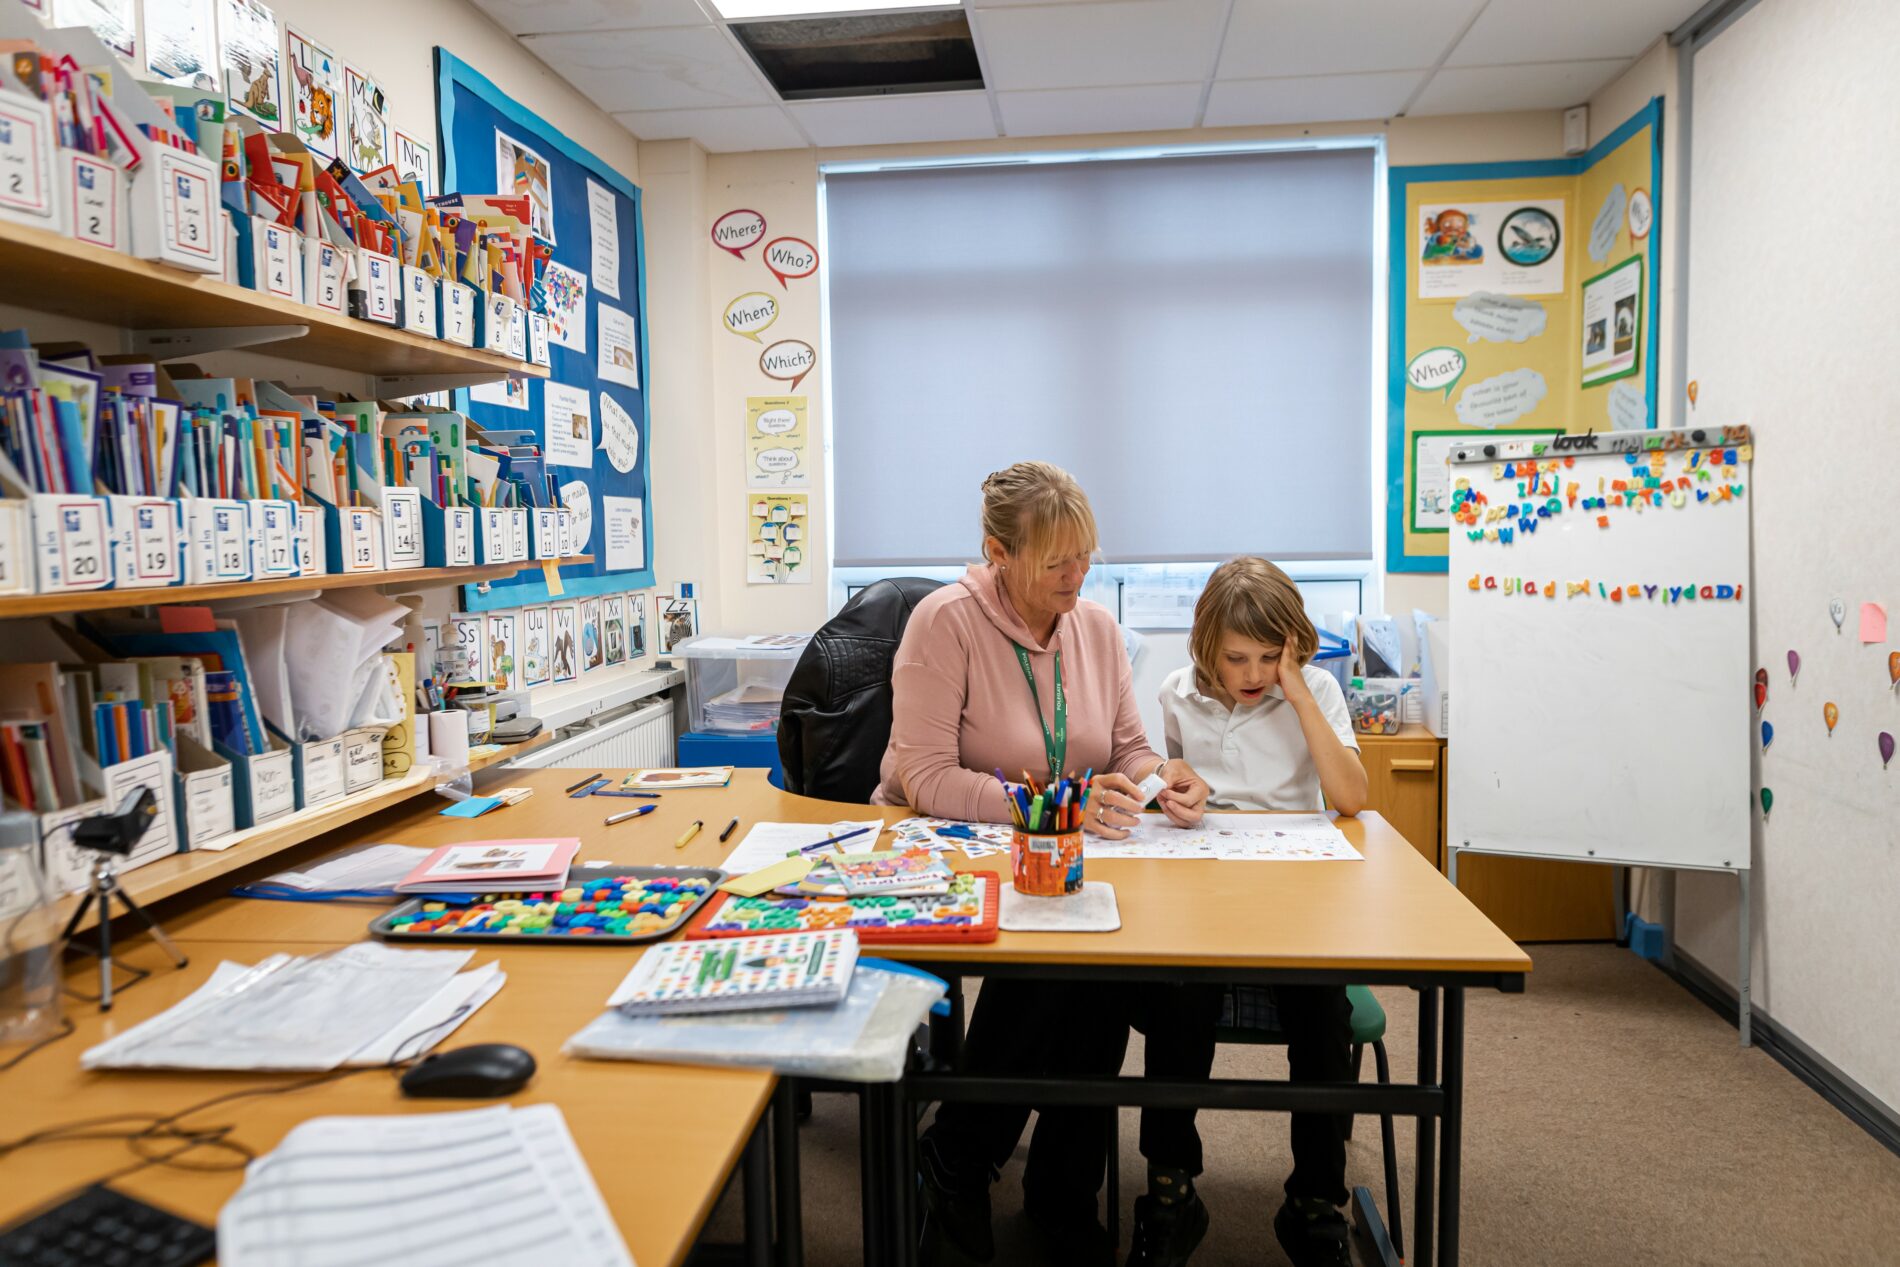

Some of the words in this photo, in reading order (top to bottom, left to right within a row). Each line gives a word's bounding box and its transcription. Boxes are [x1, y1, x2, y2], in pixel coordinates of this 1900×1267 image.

[403, 139, 423, 171] Nn
[10, 174, 22, 193] 2
[89, 216, 100, 235] 2
[189, 224, 197, 241] 3
[714, 218, 764, 241] Where?
[771, 247, 813, 269] Who?
[275, 271, 283, 286] 4
[326, 287, 334, 301] 5
[419, 310, 425, 323] 6
[727, 299, 775, 327] When?
[456, 321, 461, 334] 7
[763, 350, 813, 370] Which?
[1409, 353, 1461, 383] What?
[1553, 428, 1598, 450] look
[457, 545, 466, 557] 14
[494, 544, 502, 555] 13
[515, 540, 521, 551] 12
[544, 541, 552, 552] 11
[561, 540, 568, 549] 10
[146, 552, 166, 570] 19
[223, 553, 240, 568] 18
[271, 549, 285, 563] 17
[303, 551, 310, 564] 6
[358, 548, 370, 562] 15
[73, 556, 98, 576] 20
[583, 602, 598, 619] Ww
[608, 601, 618, 616] Xx
[631, 597, 643, 618] Yy
[666, 600, 689, 613] Zz
[493, 618, 509, 639] Tt
[528, 611, 543, 631] Uu
[557, 613, 569, 629] Vv
[458, 623, 475, 643] Ss
